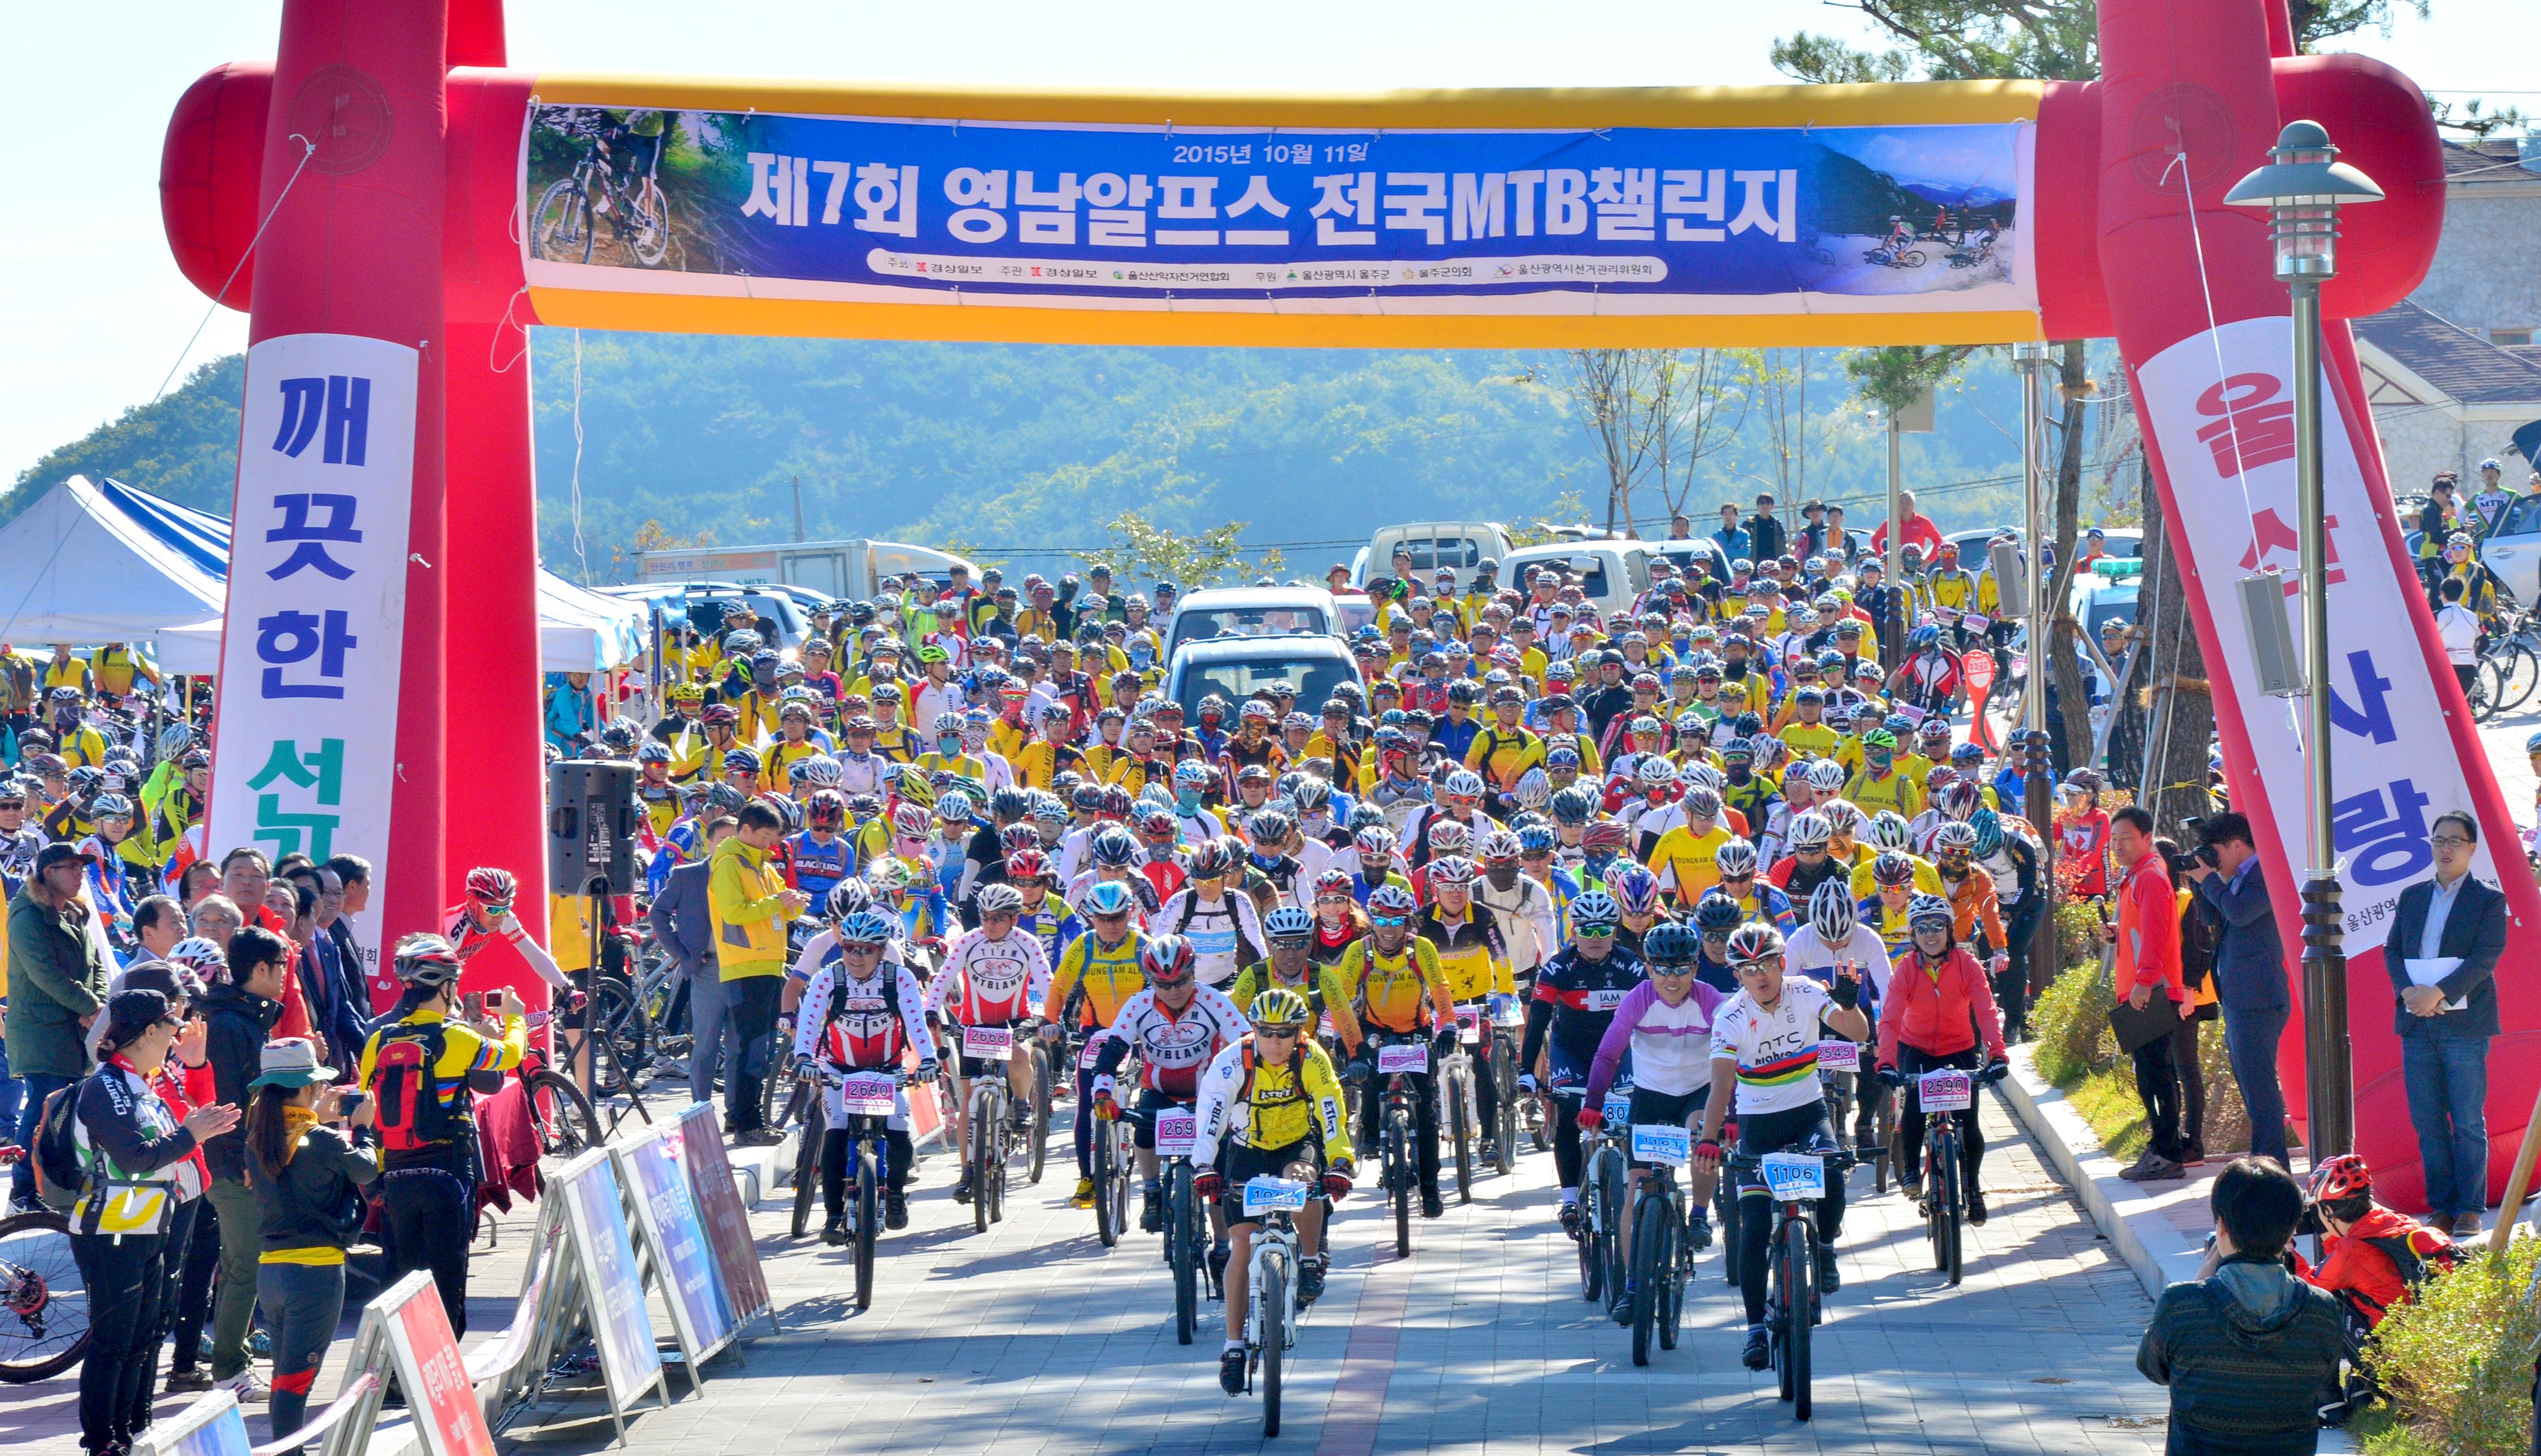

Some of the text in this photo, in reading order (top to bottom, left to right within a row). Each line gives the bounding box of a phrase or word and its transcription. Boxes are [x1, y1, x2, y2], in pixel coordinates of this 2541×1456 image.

[1173, 142, 1369, 165] 2015년 10월 11일
[741, 151, 1798, 247] 제7회 영남알프스 전국MTB챌린지
[931, 263, 983, 275] 경상일보
[1001, 266, 1022, 276] 주관
[1046, 266, 1098, 279] 경상일보
[1128, 270, 1230, 281] 울산산악자전거연합회
[1302, 269, 1355, 281] 울산광역시
[1419, 266, 1472, 279] 울주군의회
[1519, 263, 1652, 276] 울산광역시선거관리위원회
[1255, 271, 1276, 282] 후원
[256, 375, 371, 700] 깨끗한
[981, 948, 1018, 958] TEAM
[1086, 966, 1127, 976] OUNGAM
[972, 975, 1024, 990] MTBLAND
[1368, 973, 1404, 983] OUNGAM
[1599, 993, 1620, 1002] IAM
[971, 1029, 1005, 1044] 2668
[1144, 1040, 1209, 1060] MTBLAND
[1818, 1047, 1851, 1059] 2545
[1926, 1079, 1965, 1094] 2590
[1164, 1121, 1195, 1136] 269
[386, 1167, 445, 1180] EXTRICATE
[1773, 1166, 1812, 1181] 1106
